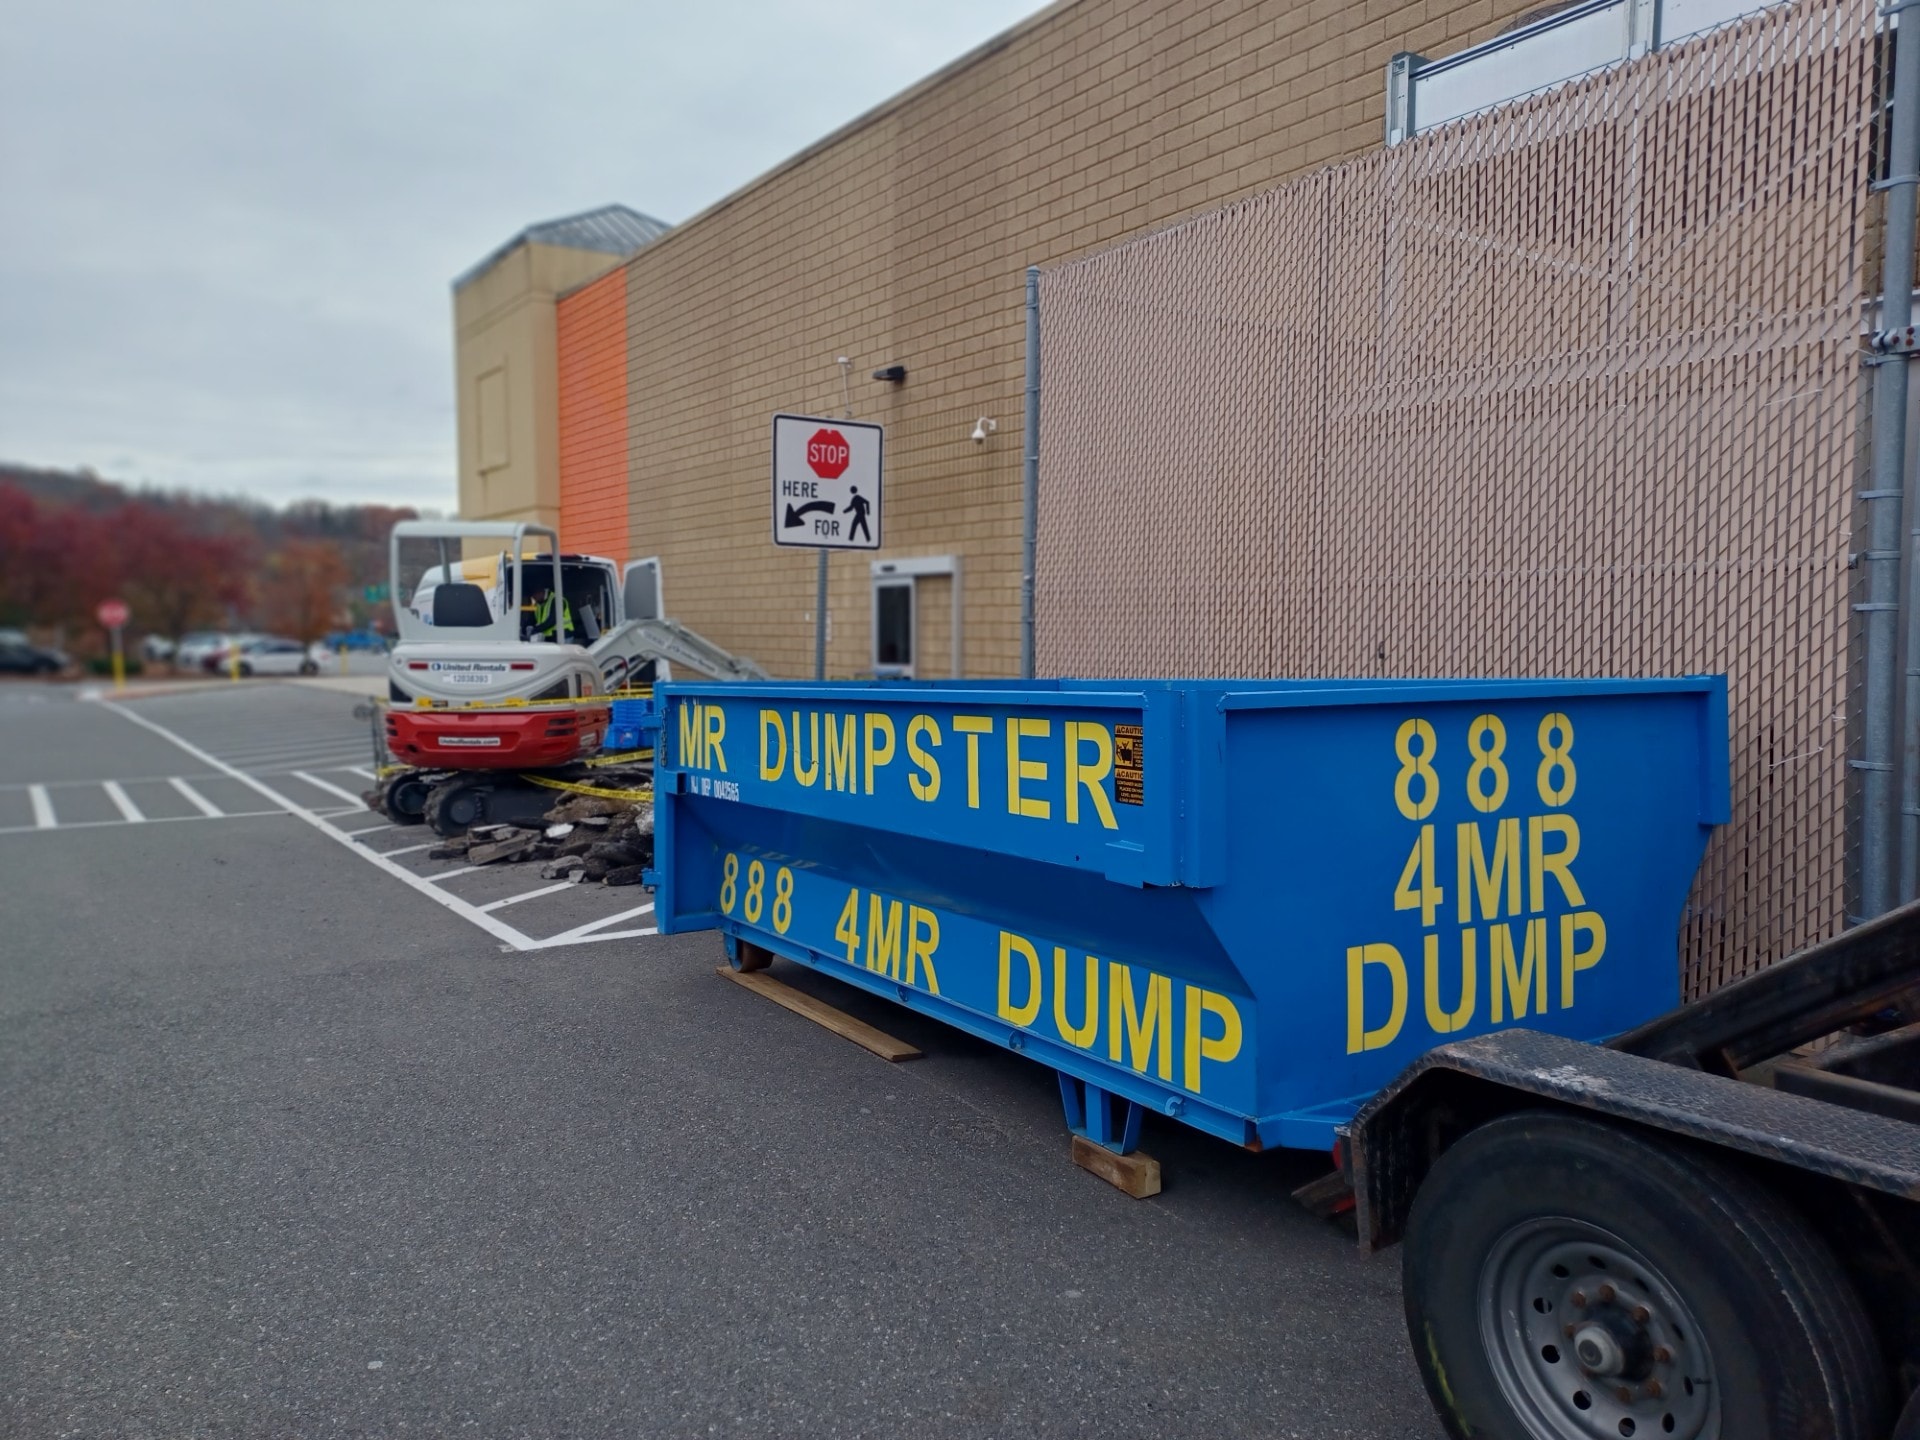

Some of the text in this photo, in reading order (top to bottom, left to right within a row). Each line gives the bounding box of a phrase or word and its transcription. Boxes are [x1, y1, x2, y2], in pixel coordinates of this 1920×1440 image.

[809, 443, 847, 465] STOP
[782, 480, 818, 499] HERE
[815, 519, 840, 536] FOR
[443, 663, 506, 672] United Rentals
[1120, 726, 1143, 735] CAUTIO
[679, 702, 1119, 830] MR DUMPSTER
[1120, 771, 1143, 780] CAUTIO
[1394, 813, 1586, 927] 4MR
[720, 852, 1243, 1094] 888 4MR DUMP
[1347, 911, 1607, 1055] DUMP
